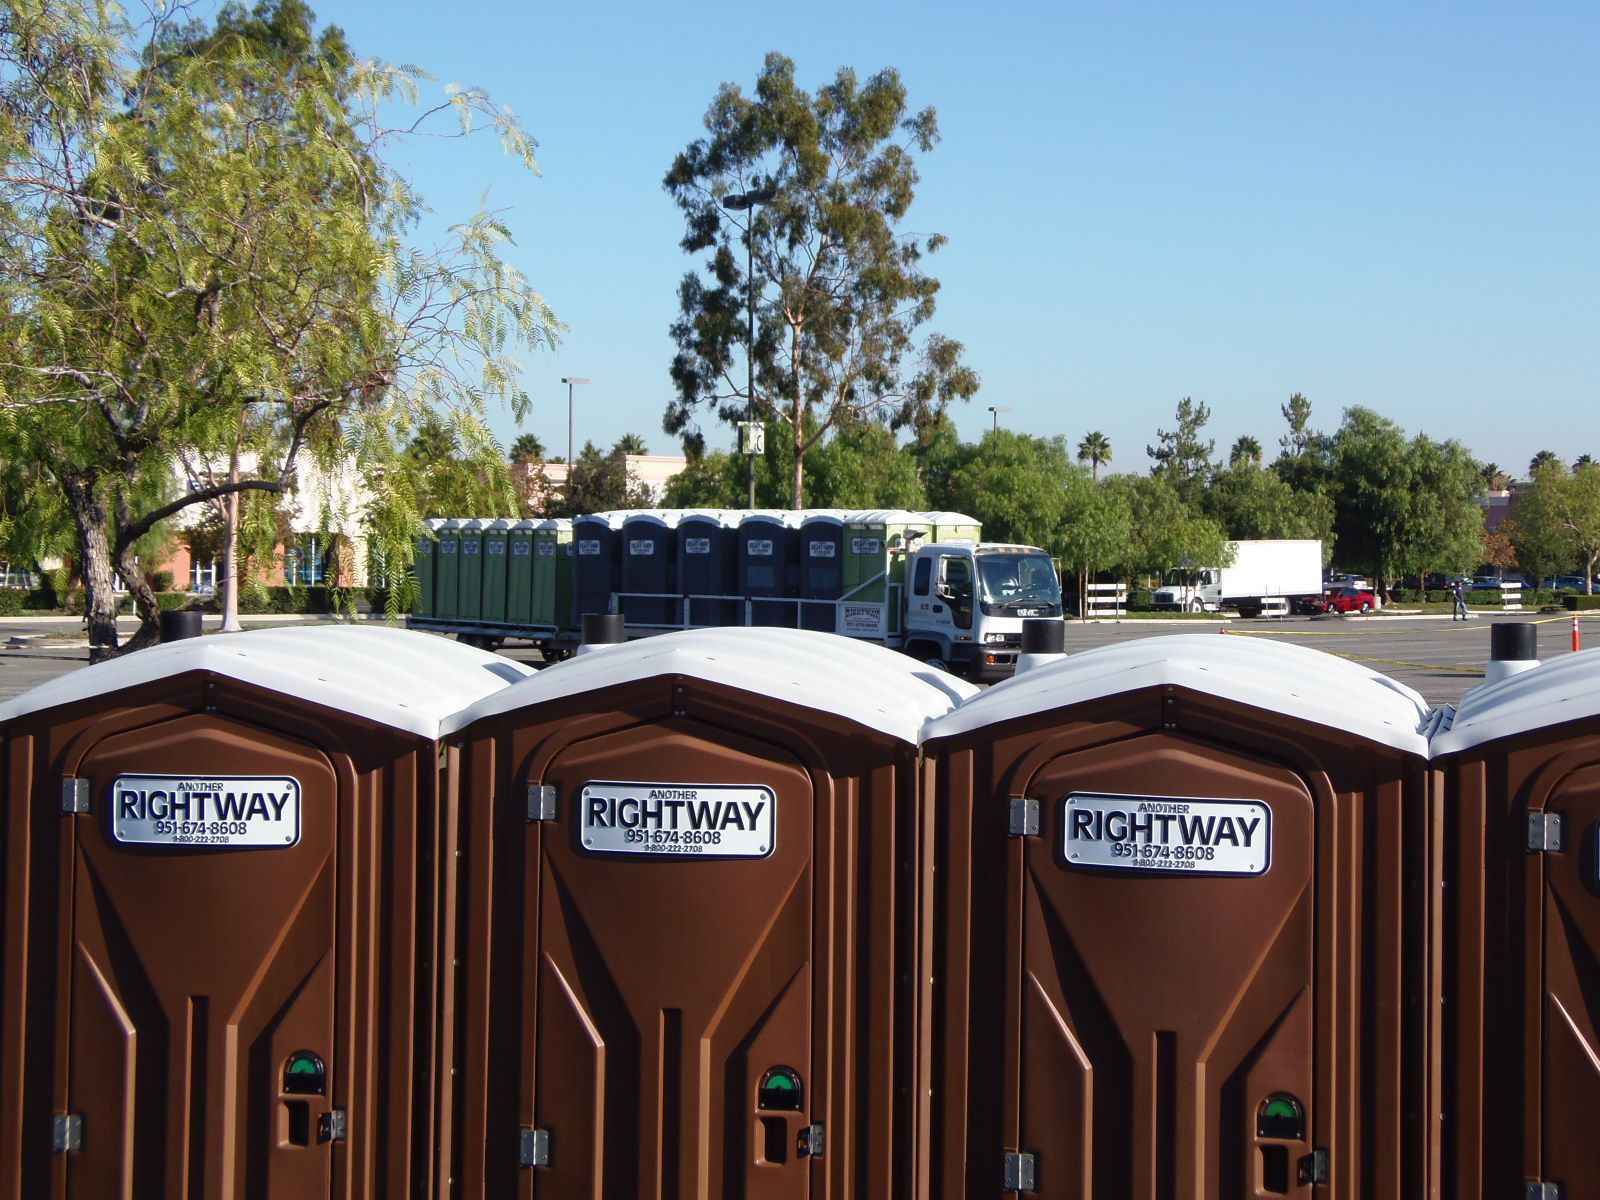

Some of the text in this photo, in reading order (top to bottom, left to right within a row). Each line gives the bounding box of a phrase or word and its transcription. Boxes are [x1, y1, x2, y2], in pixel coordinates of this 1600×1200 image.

[1017, 608, 1039, 617] GMC
[177, 782, 224, 791] ANOTHER
[649, 789, 698, 800] ANOTHER
[120, 790, 290, 821] RIGHTWAY
[1138, 802, 1190, 814] ANOTHER
[588, 797, 765, 831] RIGHTWAY
[156, 820, 247, 835] 951-674-8608
[1073, 809, 1261, 848] RIGHTWAY
[626, 829, 721, 845] 951-674-8608
[1114, 842, 1215, 860] 951-674-8608
